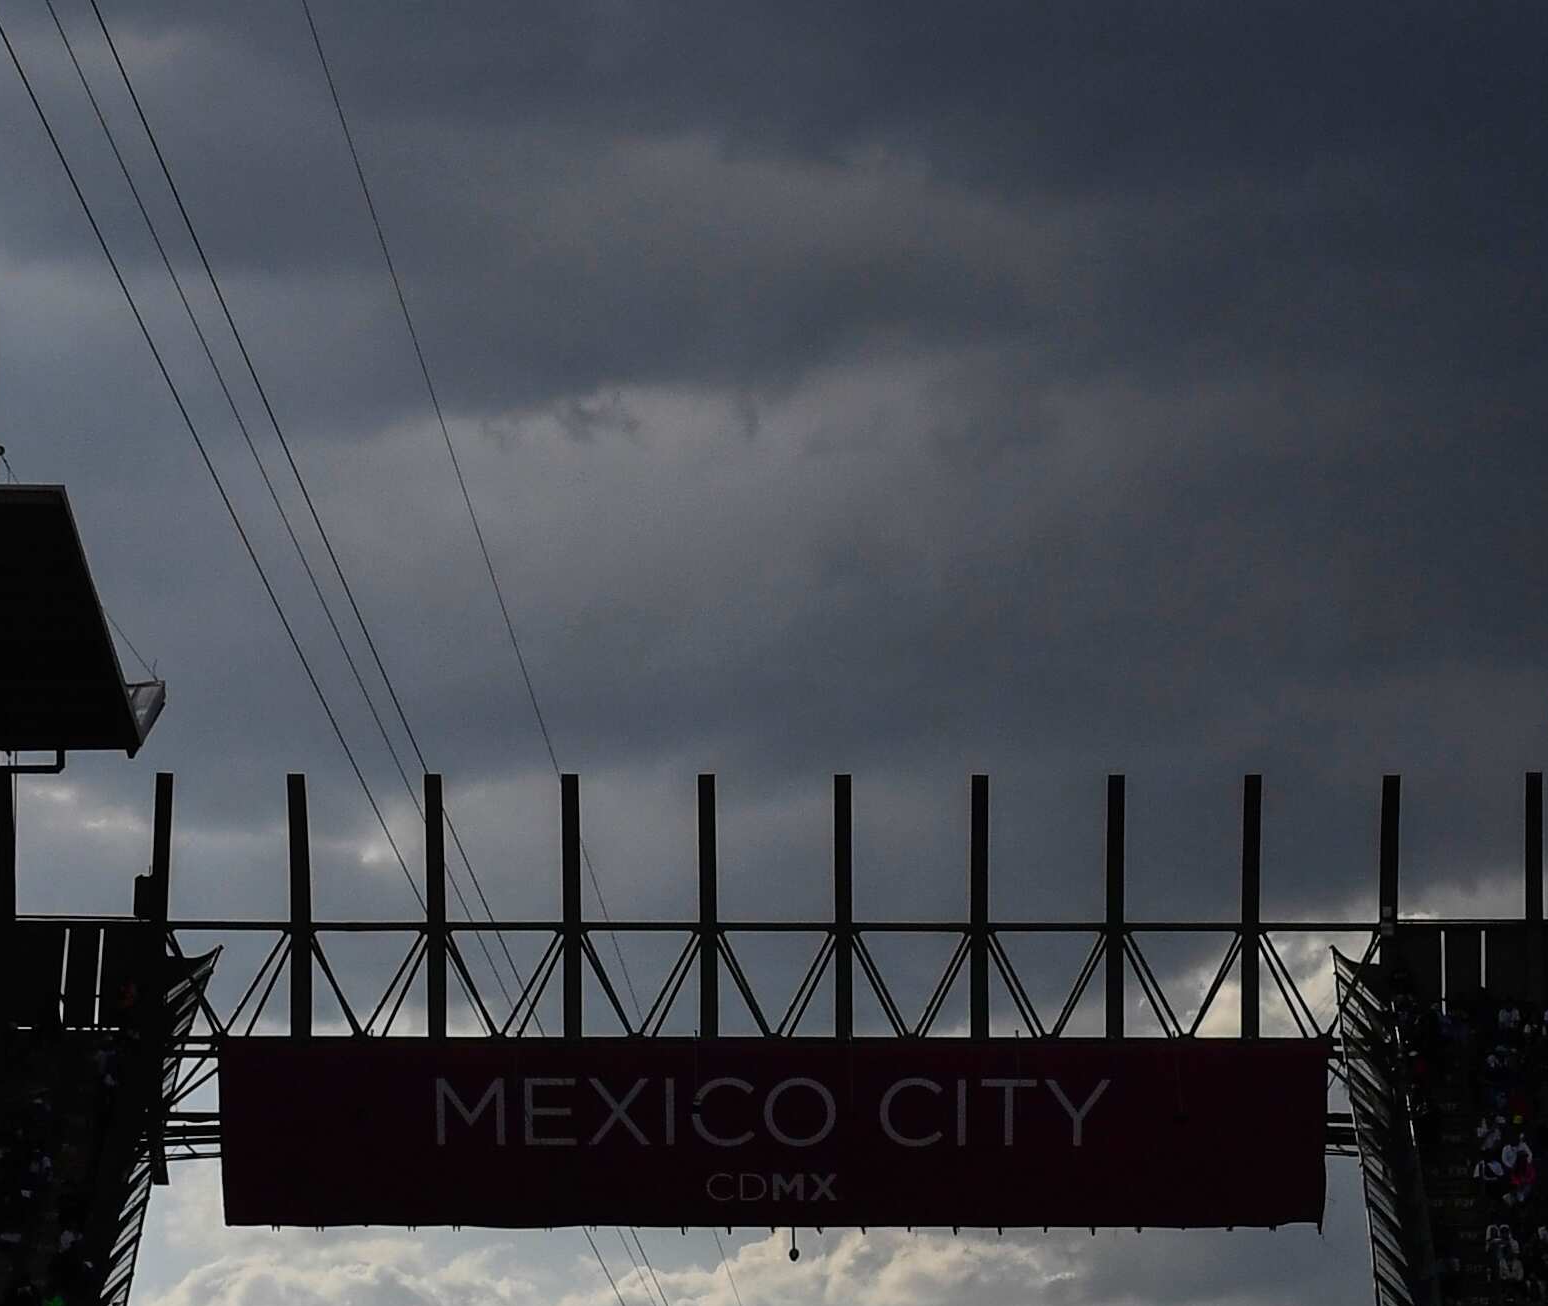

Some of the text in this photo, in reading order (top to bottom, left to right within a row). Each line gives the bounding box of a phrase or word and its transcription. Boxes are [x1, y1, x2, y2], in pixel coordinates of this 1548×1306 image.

[433, 1077, 1111, 1147] MEXICO CITY
[705, 1173, 838, 1202] CDMX
